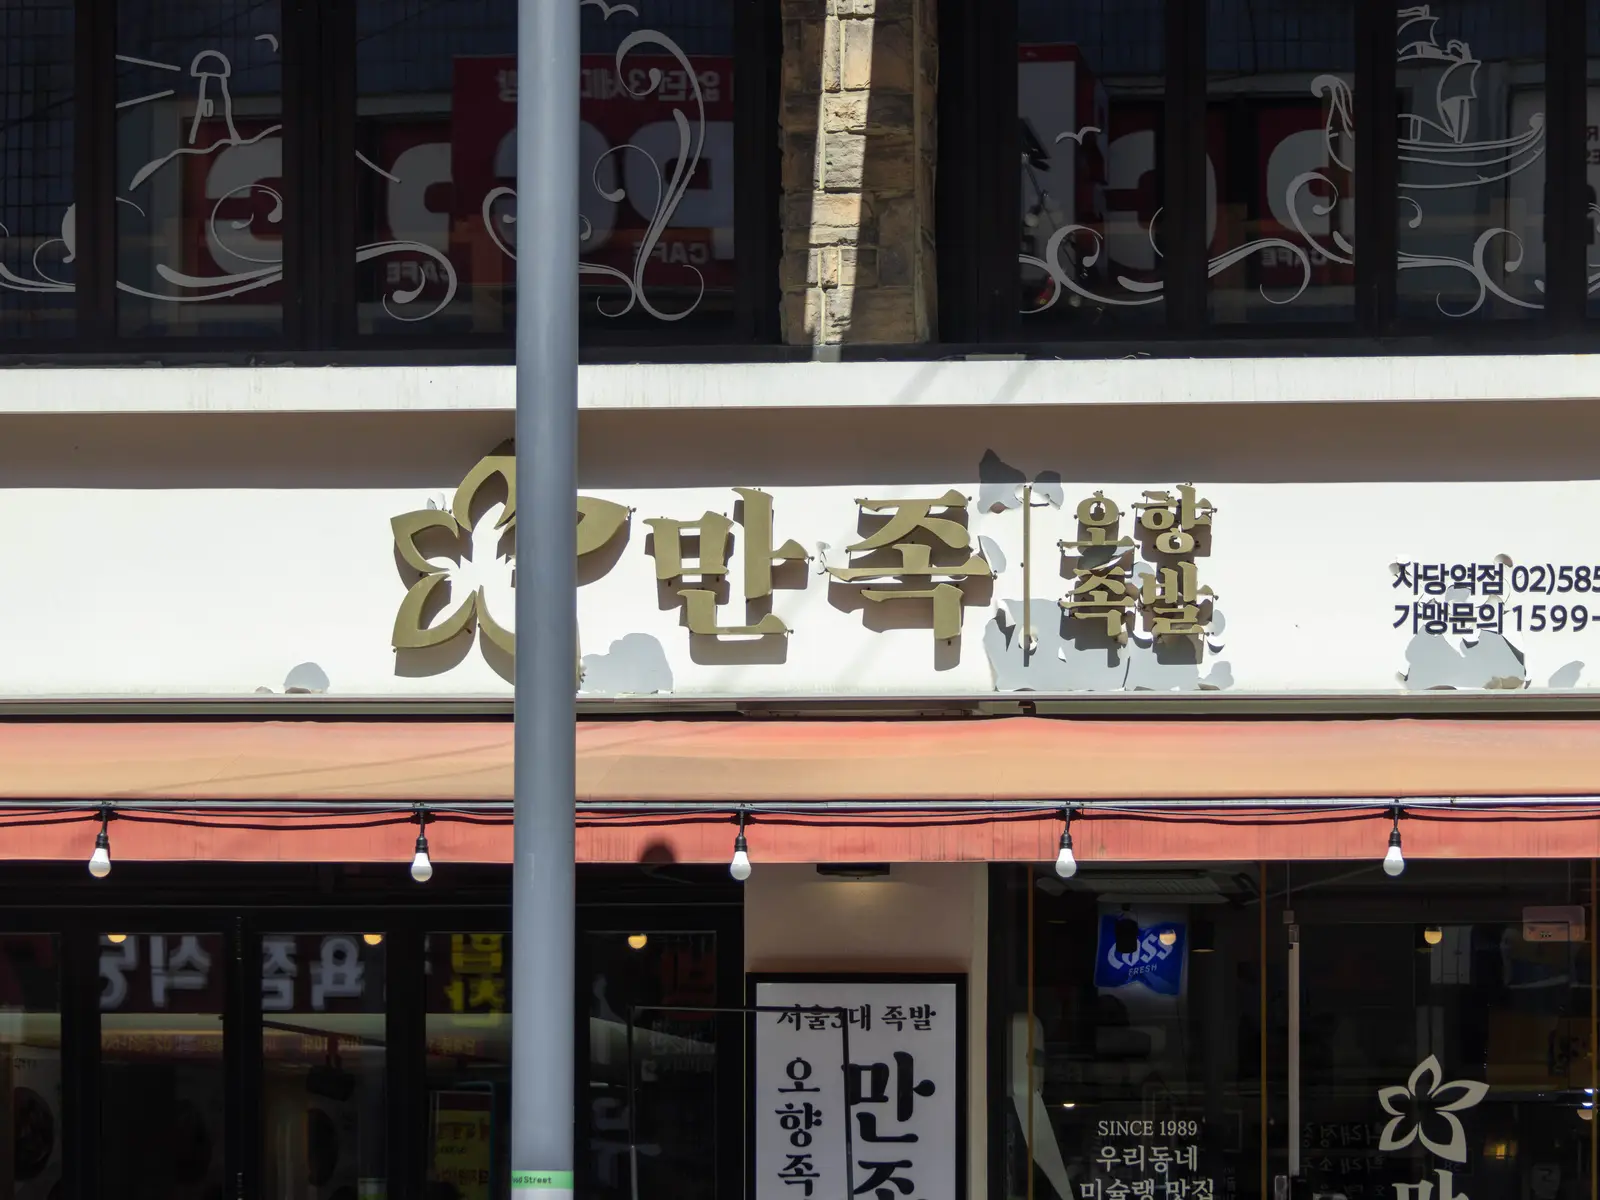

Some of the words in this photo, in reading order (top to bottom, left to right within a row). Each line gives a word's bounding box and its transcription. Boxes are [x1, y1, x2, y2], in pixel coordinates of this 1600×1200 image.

[643, 487, 998, 640] 만족
[1392, 602, 1504, 634] 가맹문의
[1128, 963, 1158, 977] FRESH
[881, 1004, 937, 1031] 족발
[1098, 1120, 1154, 1136] SINCE
[1160, 1120, 1198, 1136] 1989
[1096, 1145, 1198, 1172] 우리동네
[524, 1175, 552, 1184] Street
